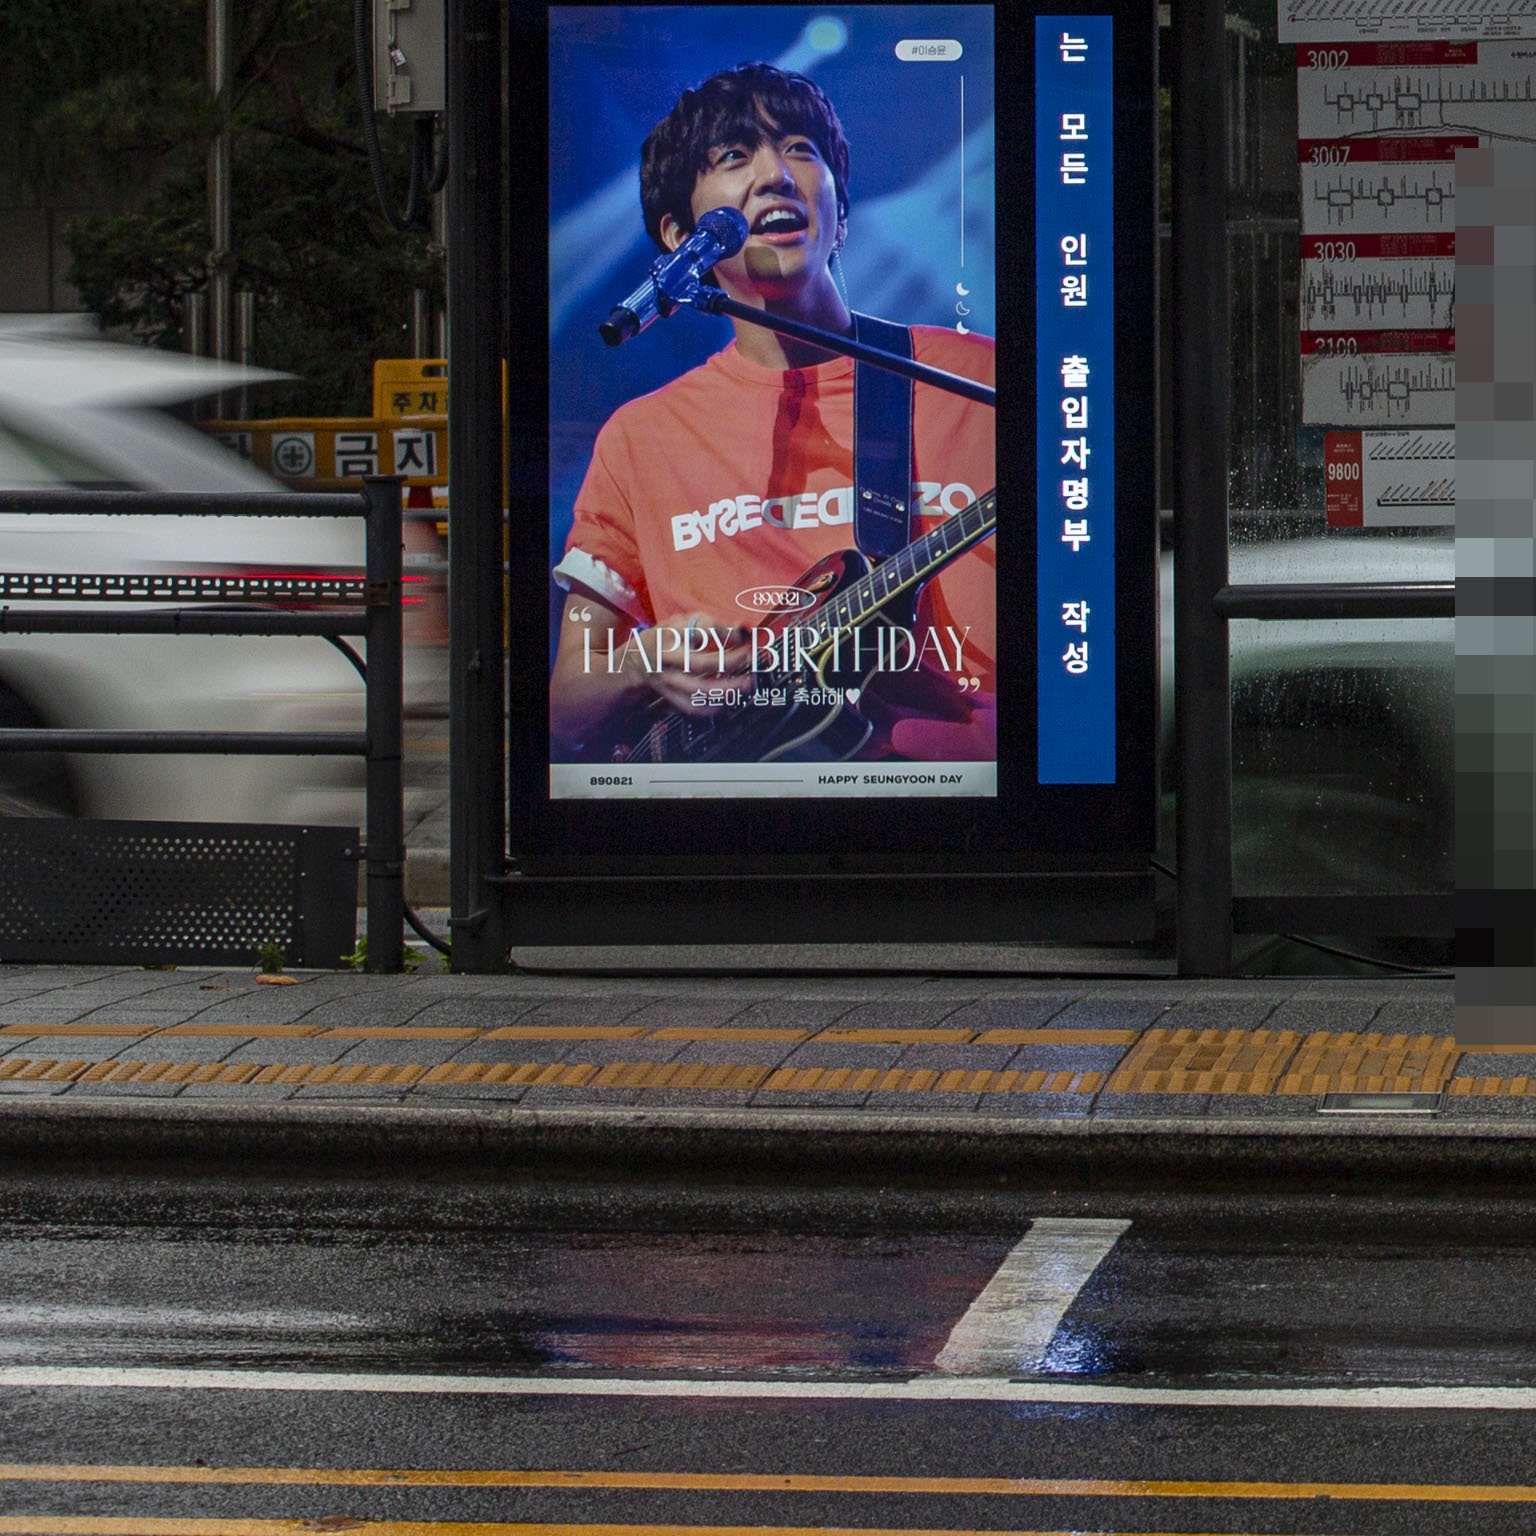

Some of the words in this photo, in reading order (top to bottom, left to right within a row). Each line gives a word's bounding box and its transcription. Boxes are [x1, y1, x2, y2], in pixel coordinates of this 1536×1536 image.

[1060, 32, 1089, 63] 는
[1307, 50, 1350, 72] 3002
[1060, 113, 1089, 185] 모든
[1308, 145, 1350, 167] 3007
[1313, 241, 1357, 263] 3030
[1060, 233, 1089, 308] 인원
[337, 434, 434, 476] 금지
[1060, 355, 1092, 551] 출입자명부
[1328, 462, 1360, 481] 9800
[752, 591, 800, 606] 890821
[1061, 601, 1091, 675] 작성
[690, 687, 748, 708] 승윤아,
[752, 687, 787, 707] 생일
[589, 776, 634, 786] 890821
[818, 775, 859, 785] HAPPY
[863, 774, 936, 785] SEUNGYOON
[939, 774, 964, 784] DAY
